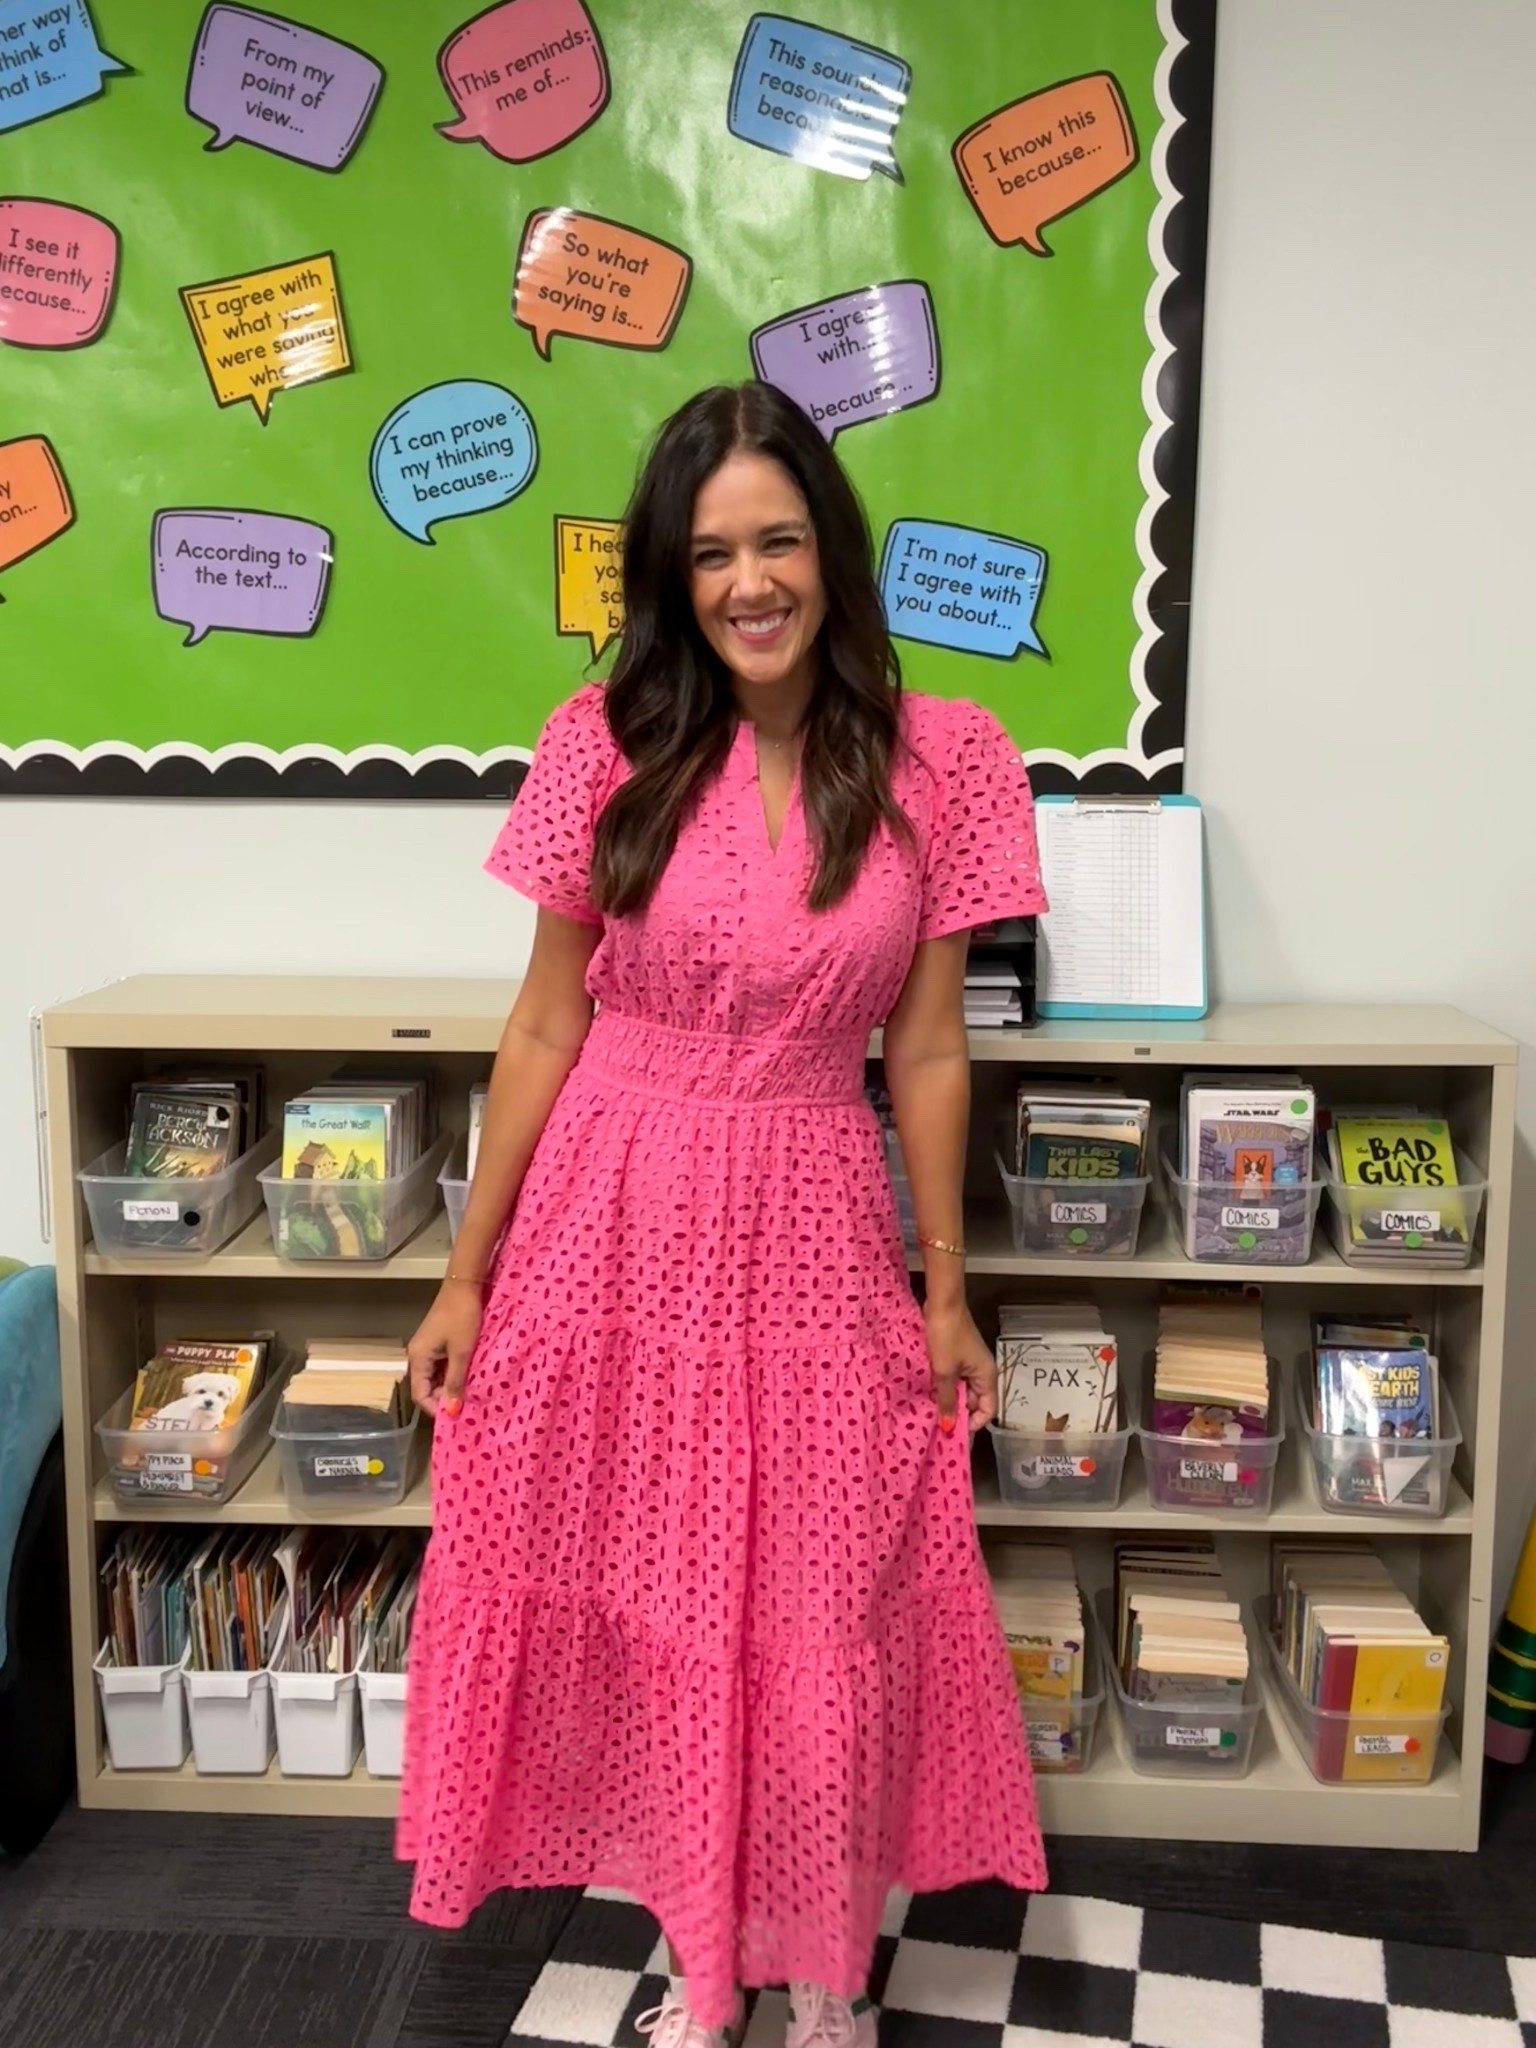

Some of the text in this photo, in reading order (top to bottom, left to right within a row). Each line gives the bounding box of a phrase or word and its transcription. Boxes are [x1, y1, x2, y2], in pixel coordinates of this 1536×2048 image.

[32, 4, 70, 30] way
[48, 28, 66, 53] of
[244, 38, 335, 90] From my
[458, 29, 584, 95] This reminds
[769, 38, 882, 96] This sound
[35, 70, 66, 87] is...
[241, 72, 326, 110] point of
[495, 68, 570, 111] me of...
[246, 101, 304, 133] view...
[983, 110, 1096, 173] I know this
[997, 145, 1102, 195] because...
[9, 228, 79, 260] I see it
[562, 232, 649, 275] So what
[0, 252, 93, 294] ifferently
[565, 266, 631, 298] you're
[0, 285, 86, 314] ecause...
[198, 269, 322, 320] I agree with
[538, 285, 643, 331] saying is...
[223, 311, 272, 341] what
[799, 322, 812, 343] I
[217, 346, 266, 369] were
[817, 336, 877, 364] with...
[389, 412, 507, 455] I can prove
[401, 438, 514, 480] my thinking
[413, 469, 514, 502] because...
[176, 539, 307, 569] According to
[573, 533, 582, 552] I
[903, 537, 1026, 580] I'm not sure
[195, 566, 288, 590] the text...
[897, 562, 1022, 606] I agree with
[895, 594, 1012, 630] you about...
[301, 1118, 317, 1129] the
[319, 1118, 348, 1130] Great
[1223, 1109, 1280, 1117] STAR WARS
[1080, 1146, 1122, 1159] LAST
[1368, 1137, 1437, 1162] BAD
[1047, 1157, 1120, 1177] KIDS
[1358, 1160, 1444, 1187] GUYS
[1055, 1204, 1098, 1222] COMICS
[1226, 1207, 1270, 1226] COMICS
[1385, 1213, 1432, 1230] COMICS
[177, 1346, 212, 1358] PUPPY
[215, 1349, 236, 1360] PLA
[1034, 1368, 1080, 1388] PAX
[1387, 1365, 1421, 1381] KIDS
[1371, 1380, 1420, 1398] EARTH
